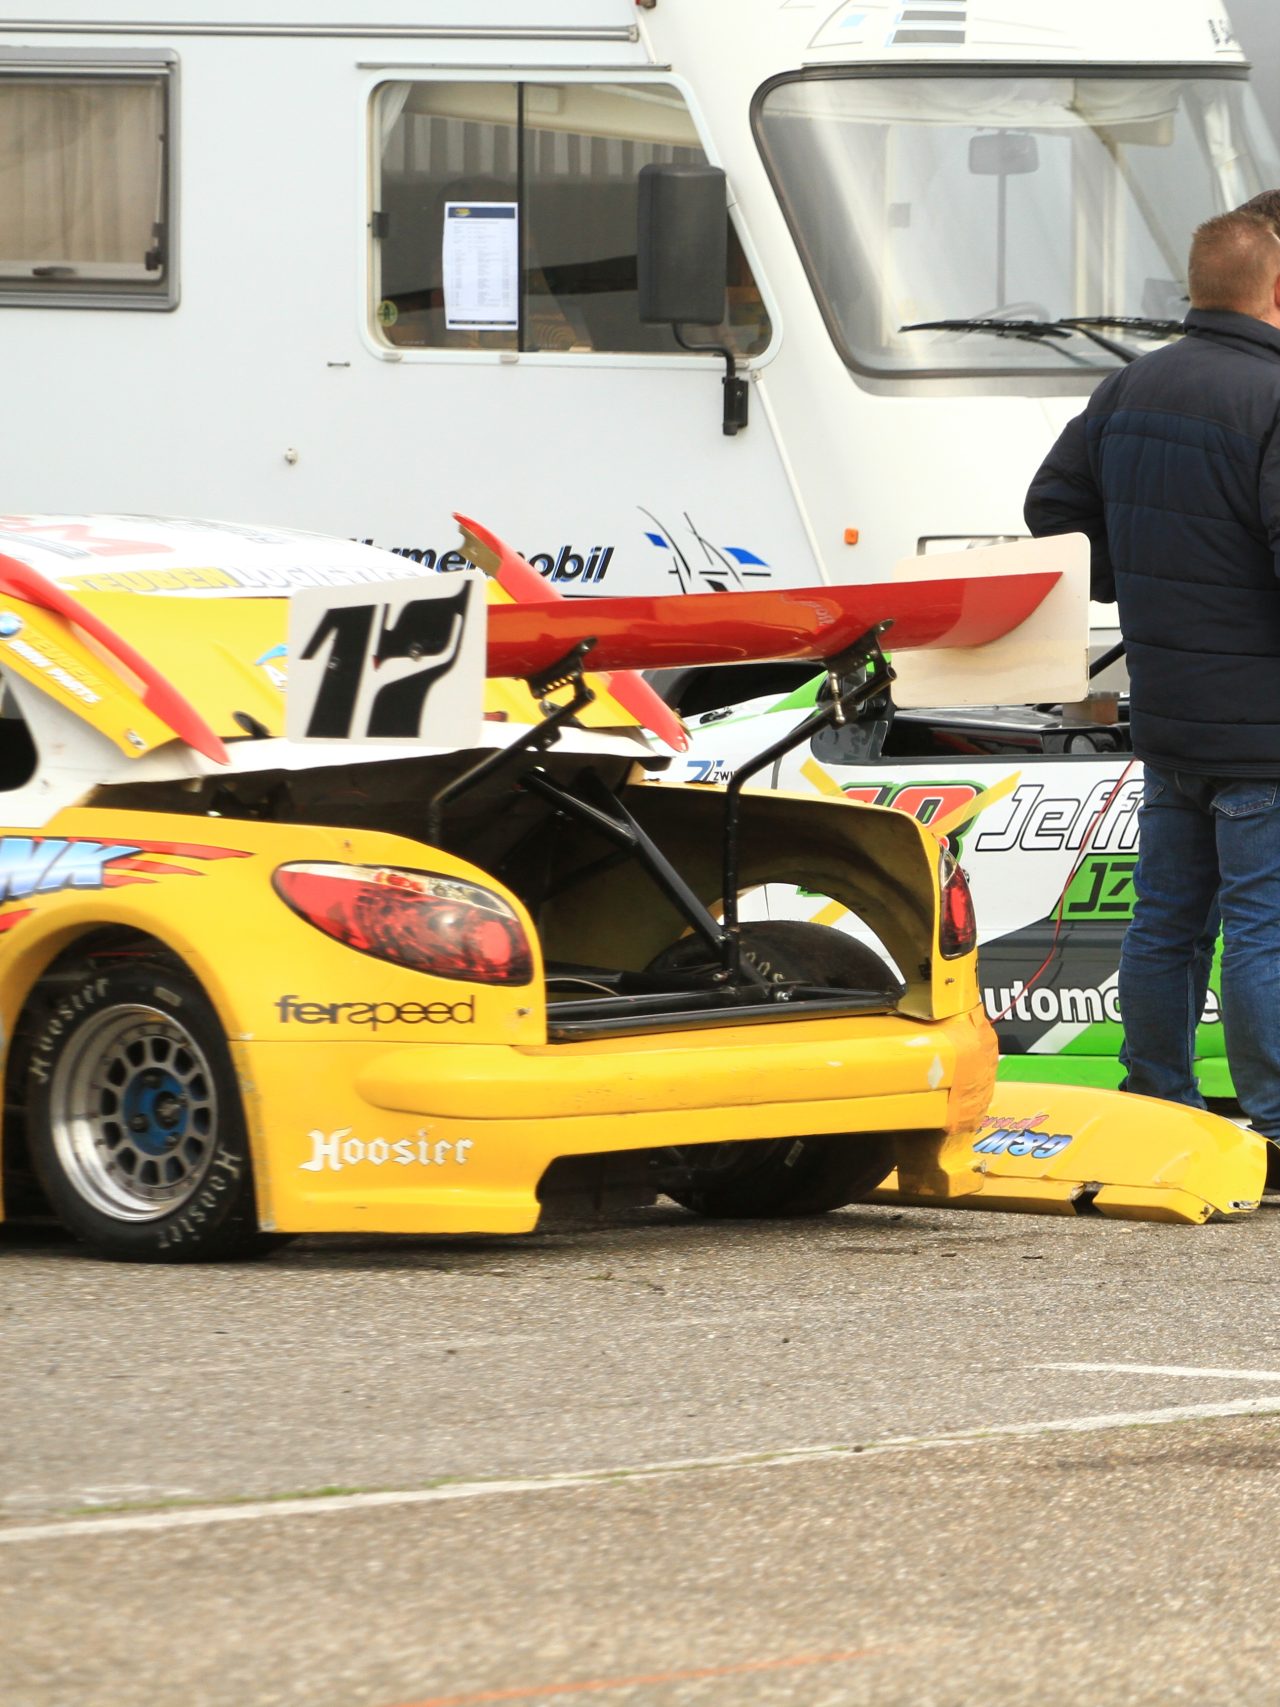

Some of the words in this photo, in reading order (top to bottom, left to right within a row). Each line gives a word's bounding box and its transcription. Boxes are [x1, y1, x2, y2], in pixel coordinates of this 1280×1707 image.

[58, 566, 240, 592] TEUBEN
[298, 579, 474, 740] 17
[275, 994, 475, 1031] ferspeed
[979, 980, 1223, 1024] utomoe
[299, 1126, 475, 1172] Hoosier
